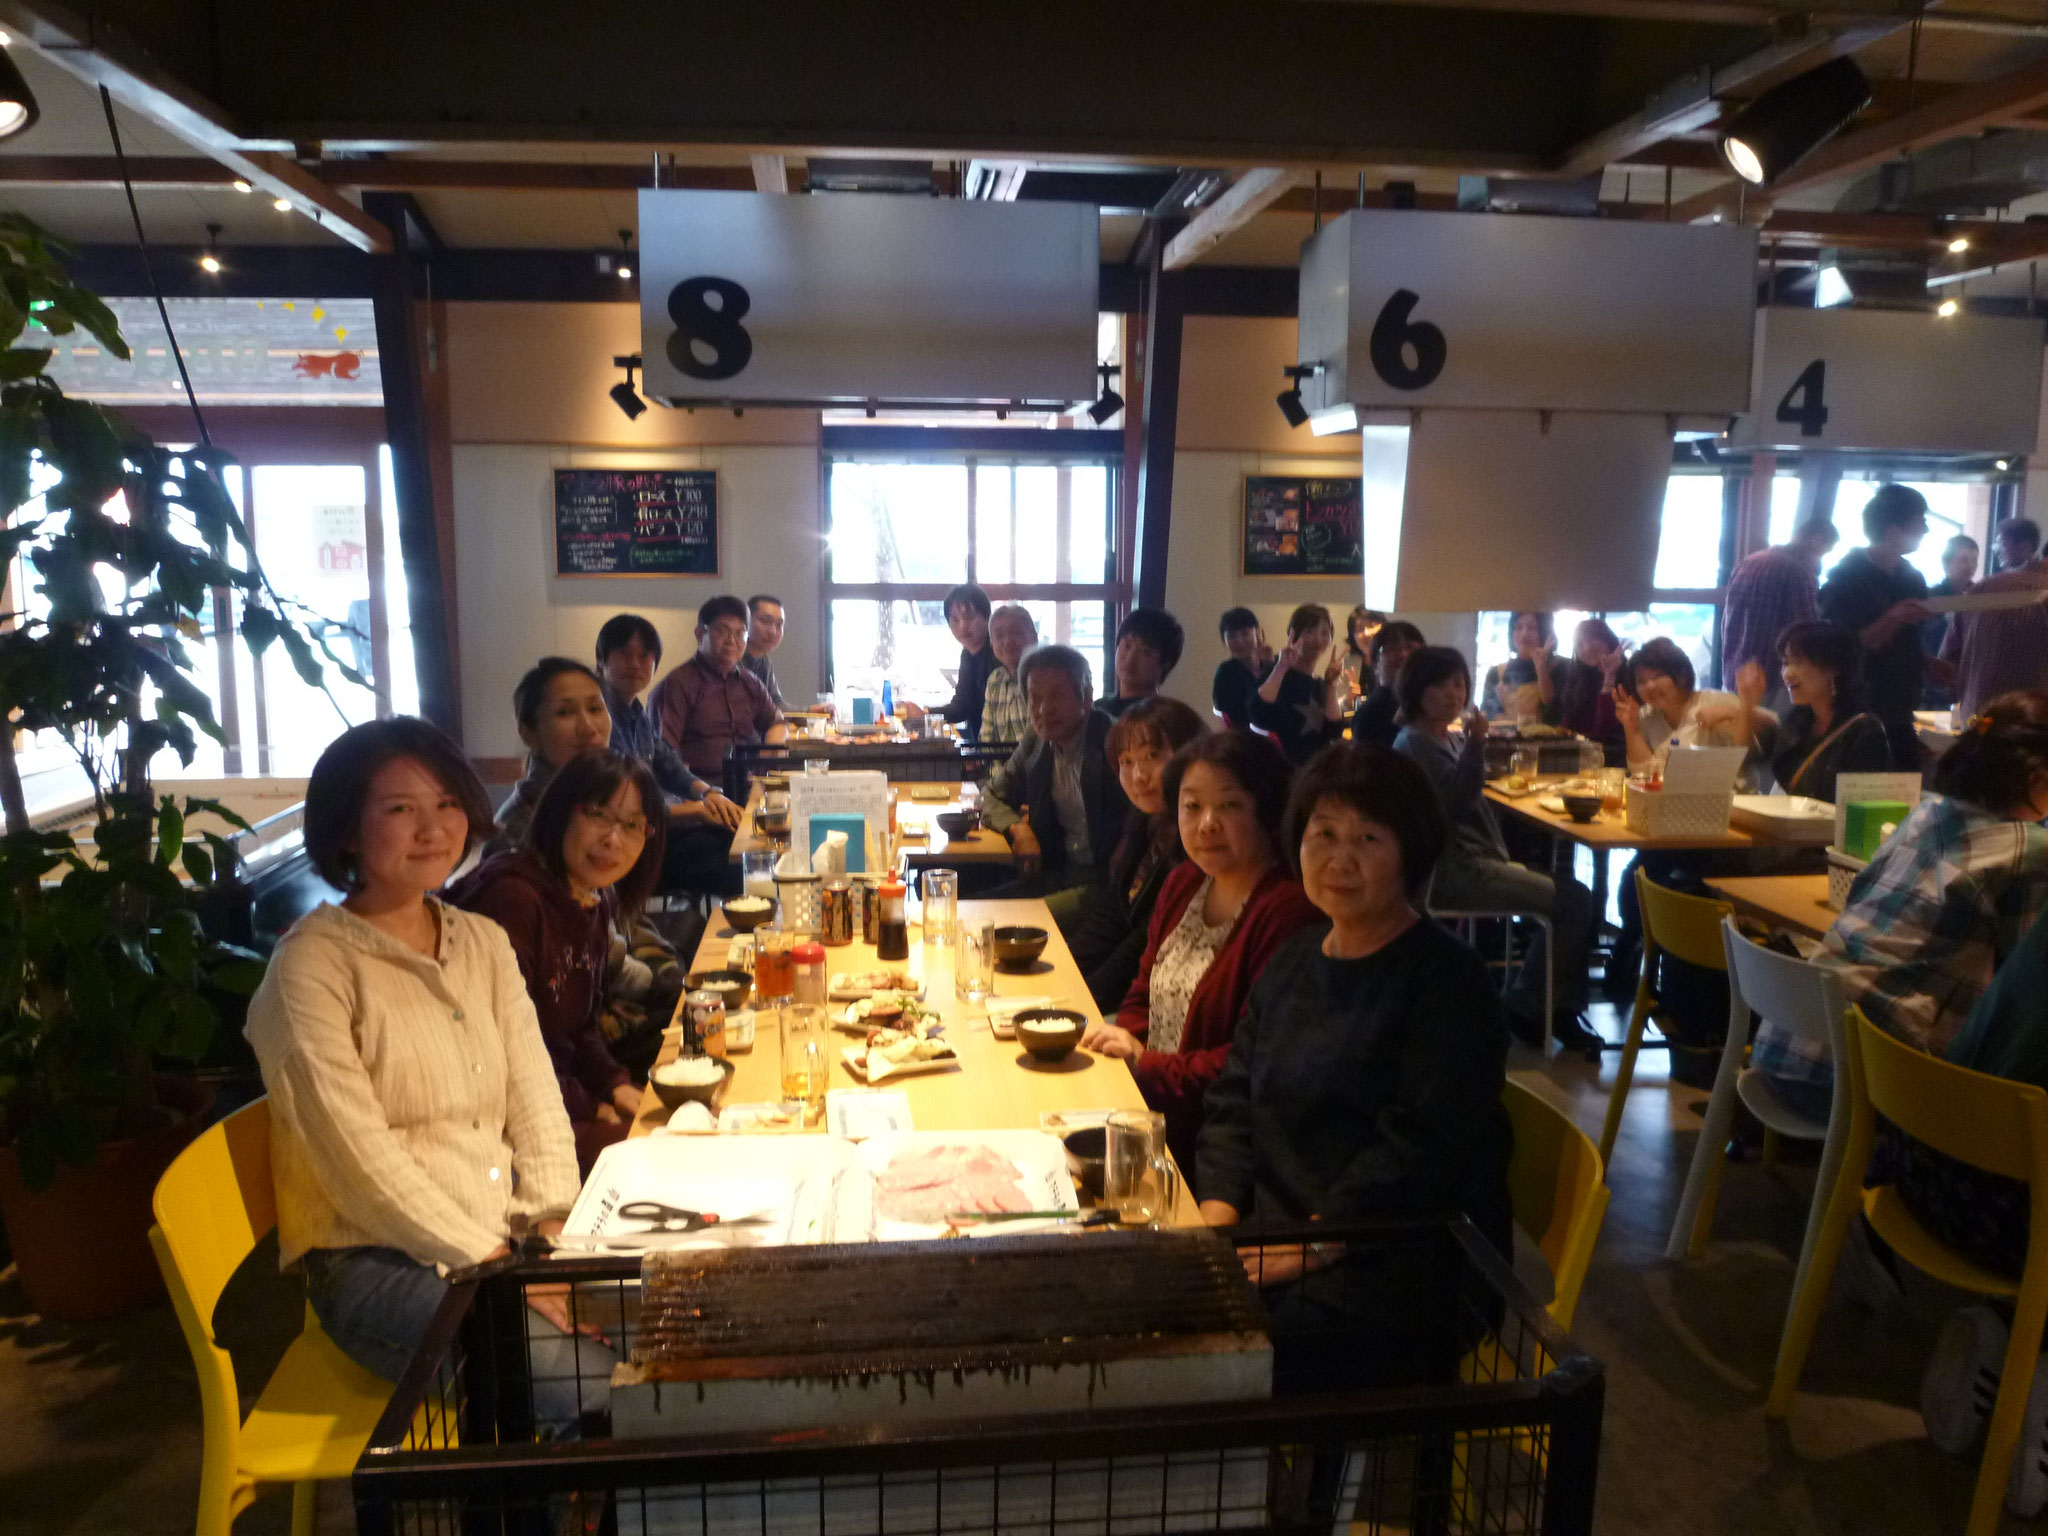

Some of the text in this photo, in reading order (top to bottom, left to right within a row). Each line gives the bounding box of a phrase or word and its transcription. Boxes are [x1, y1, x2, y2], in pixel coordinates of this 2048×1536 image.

[666, 276, 753, 381] 8
[1370, 289, 1448, 391] 6
[1776, 358, 1829, 438] 4
